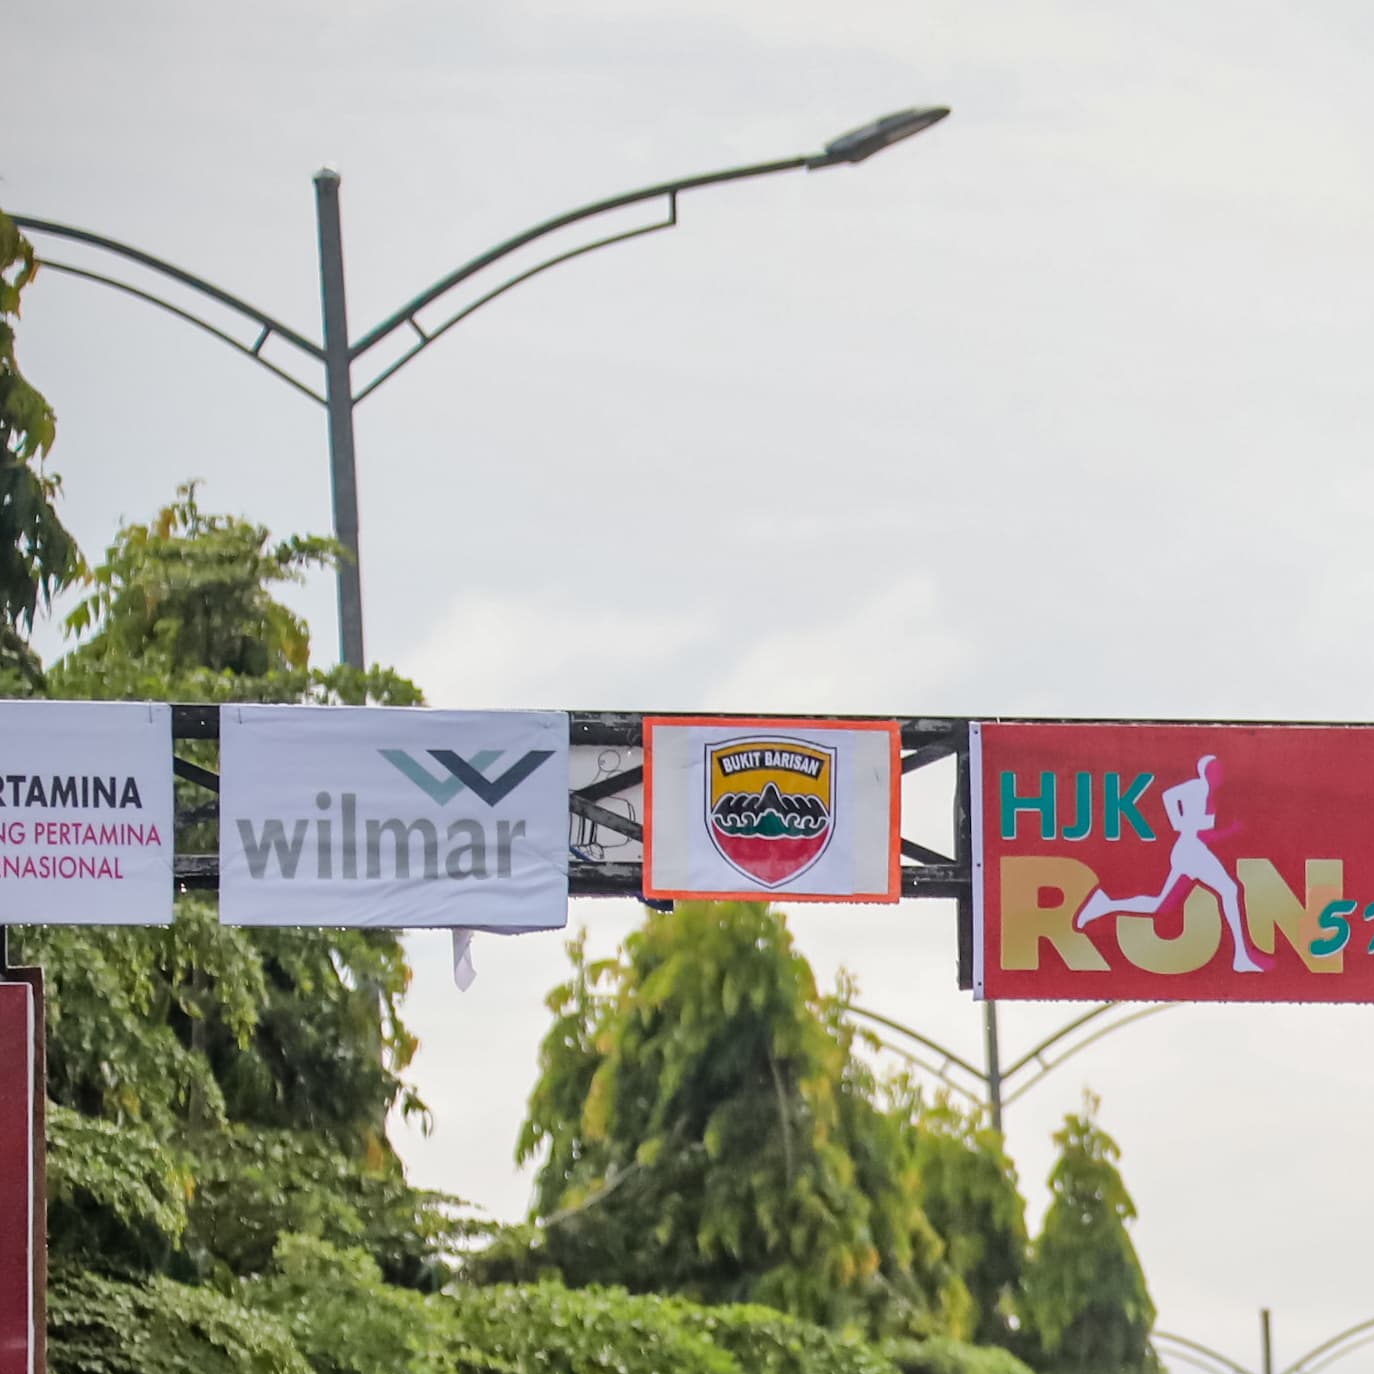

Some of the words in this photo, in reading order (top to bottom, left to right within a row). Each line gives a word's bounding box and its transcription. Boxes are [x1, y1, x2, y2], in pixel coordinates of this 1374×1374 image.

[722, 751, 761, 773] BUKIT
[764, 751, 820, 776] BARISAN
[1000, 771, 1156, 841] HJK
[34, 823, 161, 846] PERTAMINA
[237, 792, 526, 881] wilmar
[0, 856, 124, 879] NASIONAL
